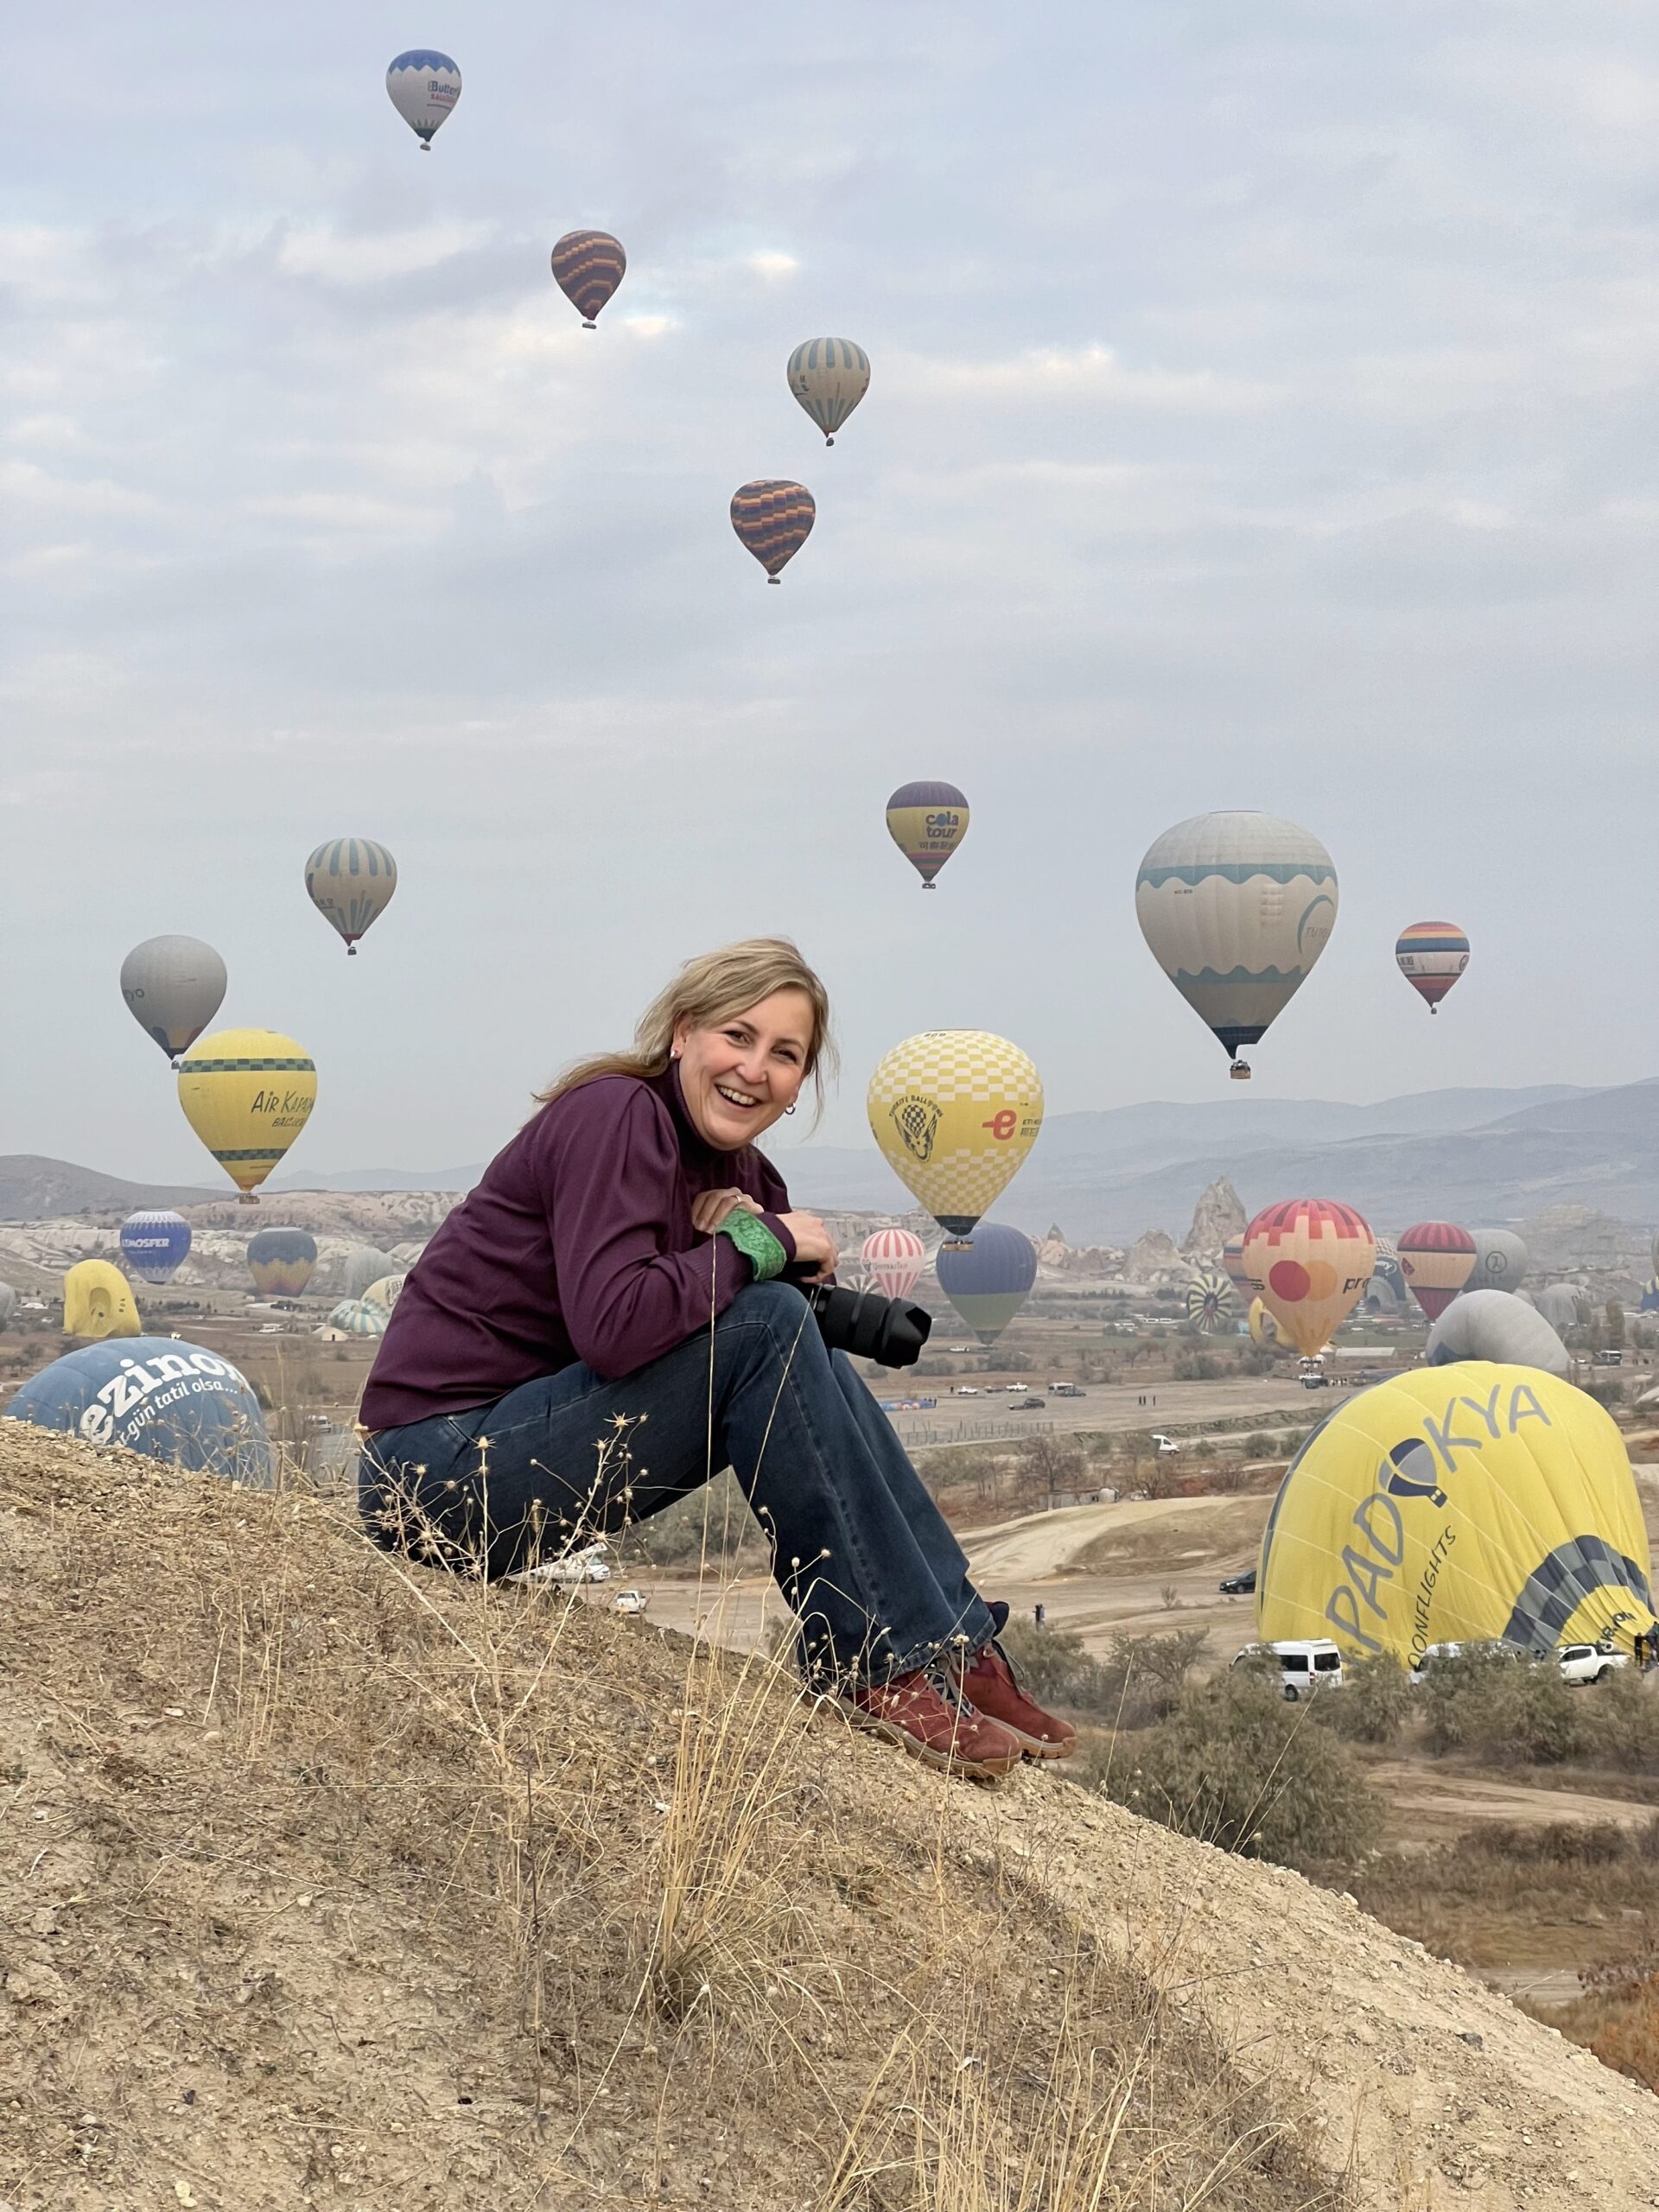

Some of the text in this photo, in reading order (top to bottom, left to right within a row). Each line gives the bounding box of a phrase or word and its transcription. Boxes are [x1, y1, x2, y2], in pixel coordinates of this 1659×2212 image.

[926, 811, 958, 827] cola
[926, 825, 957, 838] tour
[127, 1408, 156, 1441] gün
[154, 1382, 190, 1408] tatil
